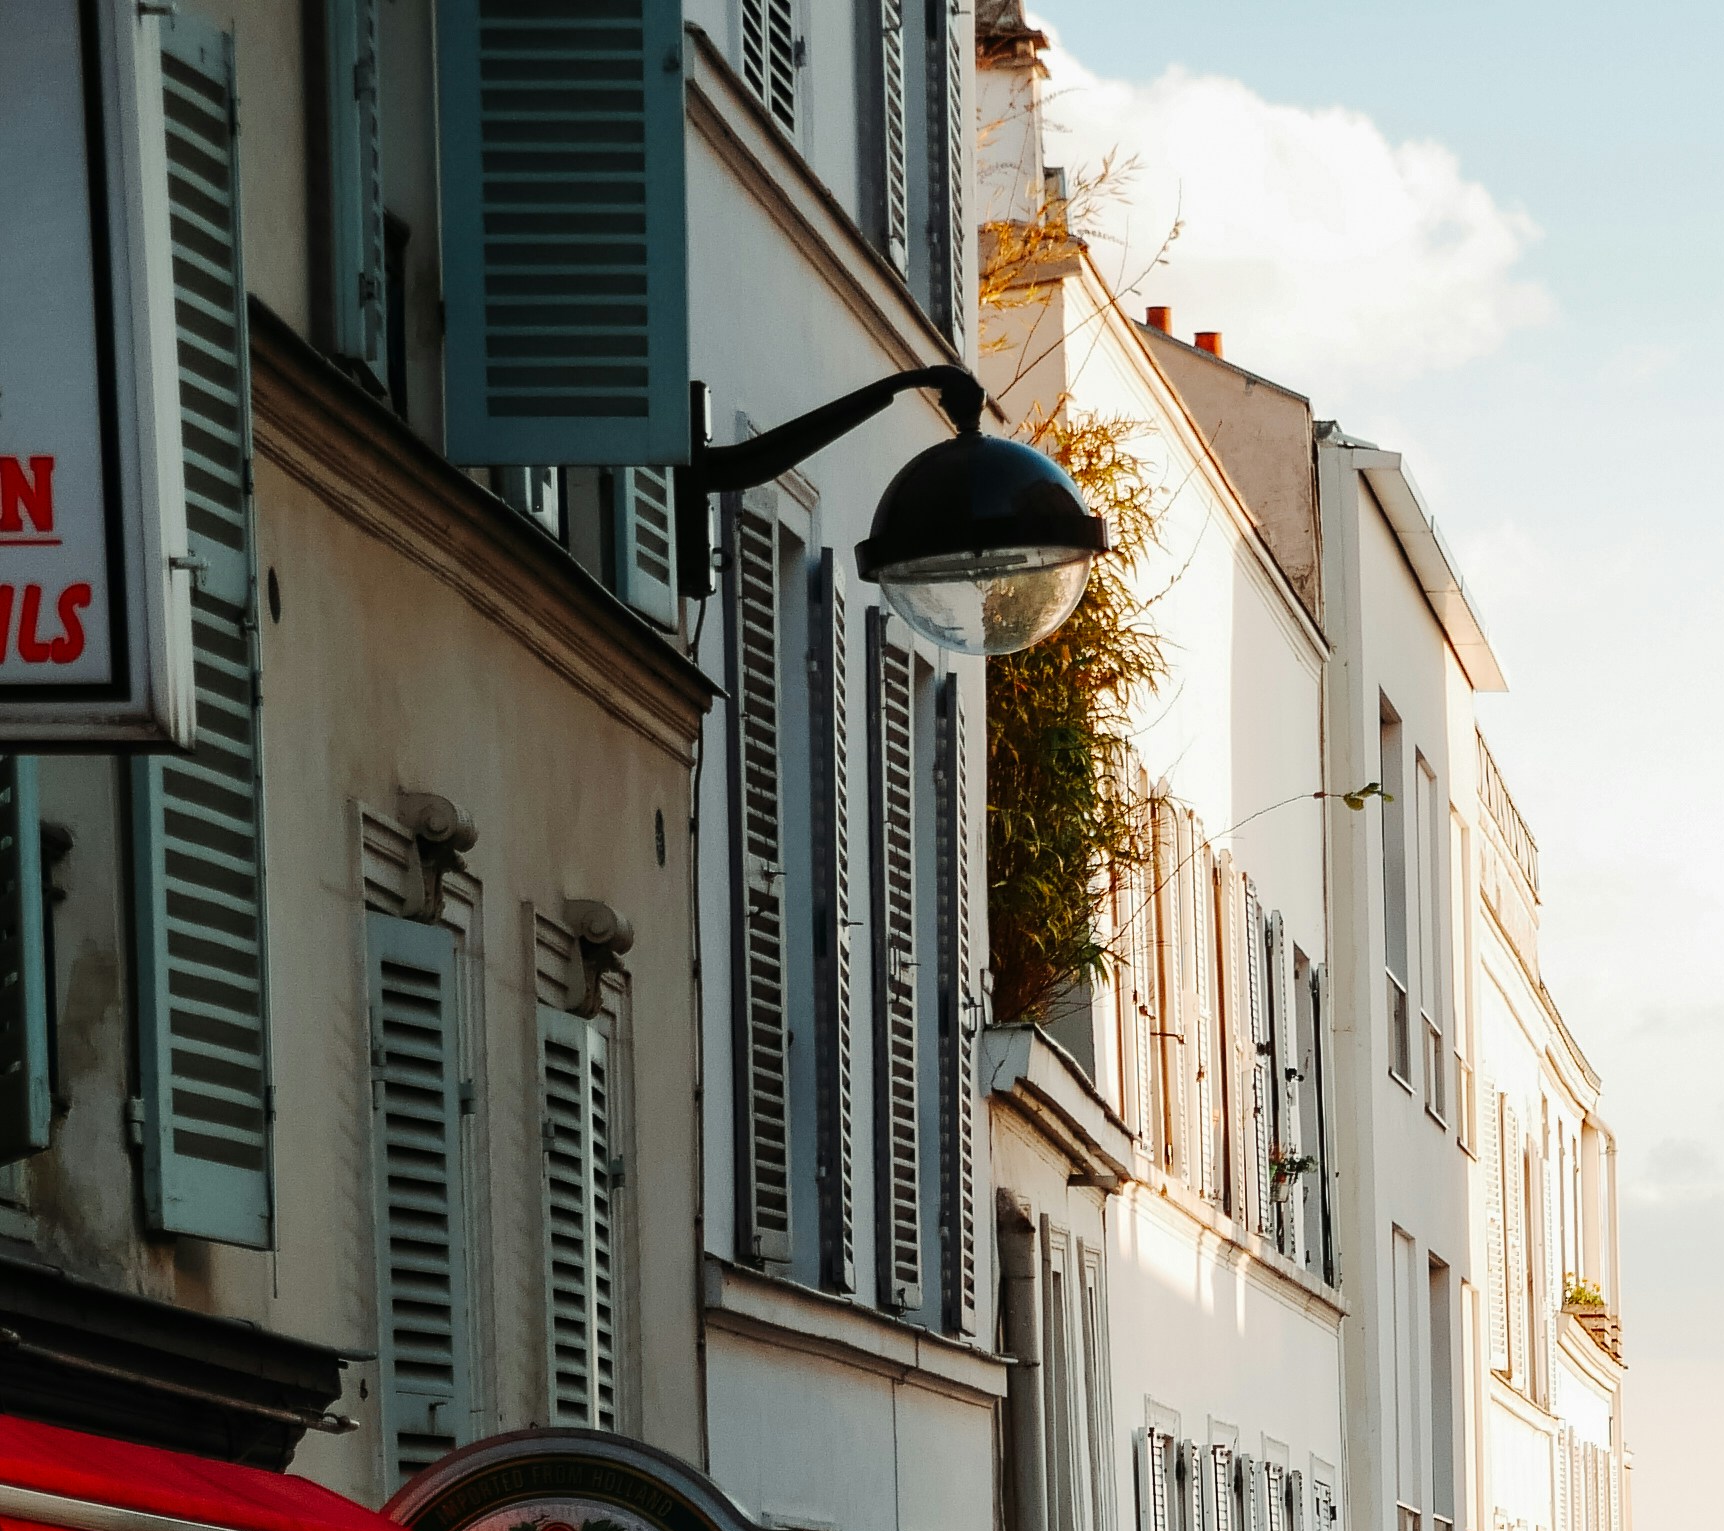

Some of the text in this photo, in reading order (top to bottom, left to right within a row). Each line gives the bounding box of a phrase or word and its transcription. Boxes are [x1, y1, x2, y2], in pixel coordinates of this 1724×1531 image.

[433, 1466, 674, 1526] IMPORTED FROM HOLLAND
